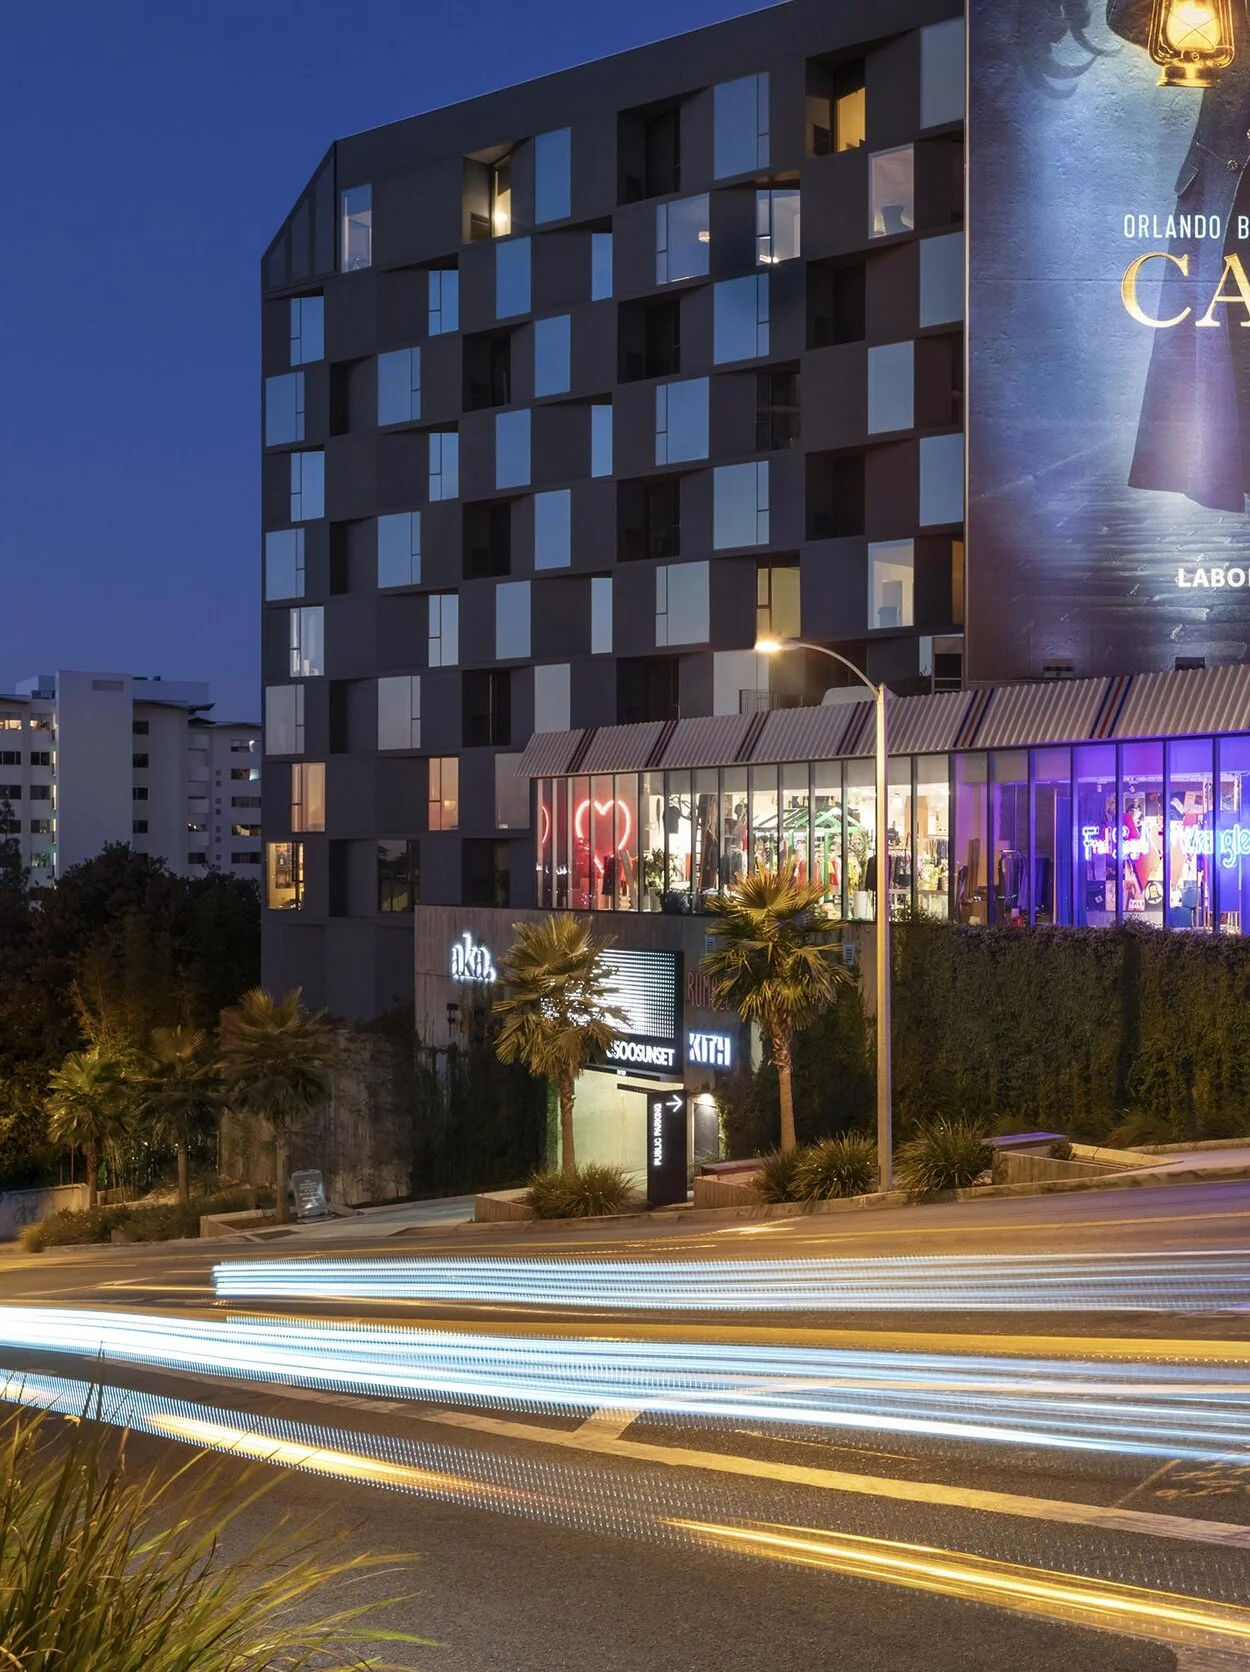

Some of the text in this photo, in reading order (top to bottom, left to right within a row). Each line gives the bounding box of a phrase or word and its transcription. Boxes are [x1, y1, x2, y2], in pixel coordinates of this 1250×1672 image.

[1123, 214, 1221, 240] ORLANDO
[689, 1032, 731, 1066] KITH
[653, 1103, 662, 1166] PUBLIC PARKING
